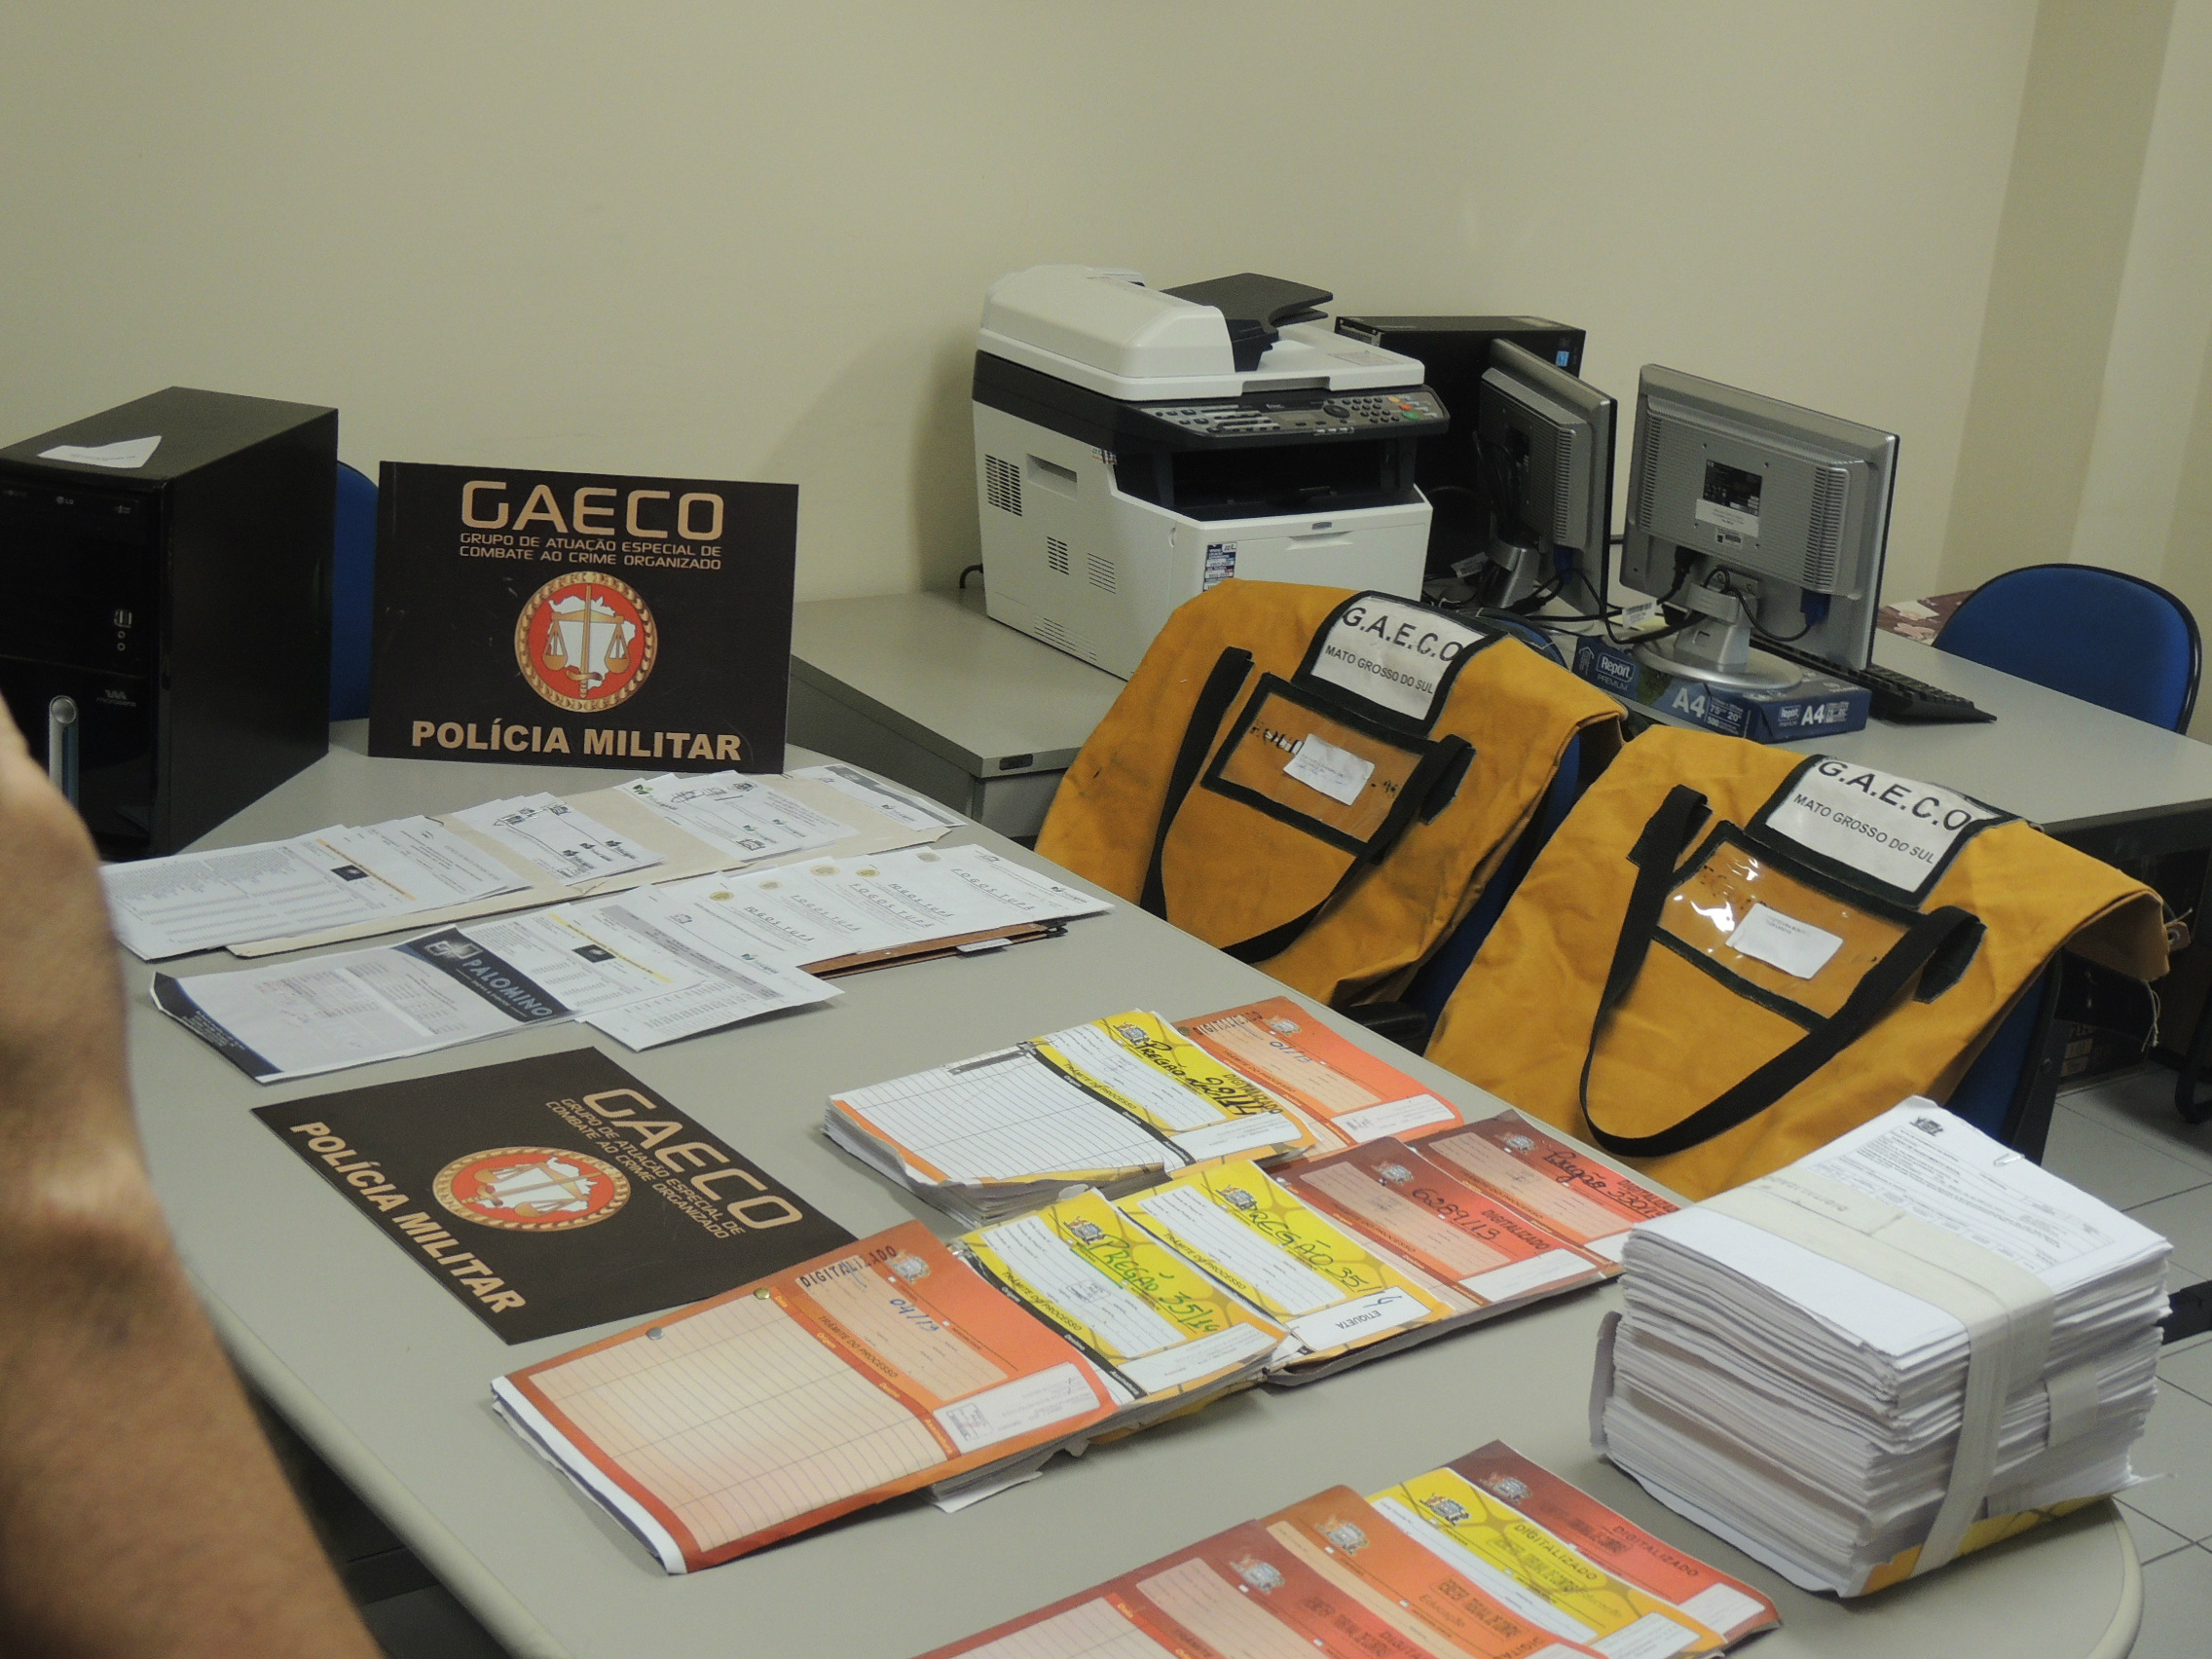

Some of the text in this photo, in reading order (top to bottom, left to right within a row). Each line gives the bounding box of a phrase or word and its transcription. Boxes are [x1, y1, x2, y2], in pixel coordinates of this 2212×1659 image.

[461, 480, 724, 541] GAECO
[460, 533, 722, 557] GRUPO DE ATUAÇÃO ESPECIAL DE
[460, 545, 722, 571] COMBATE AO CRIME ORGANIZADO
[1324, 645, 1434, 695] MATO GROSSO DO SUL
[1601, 656, 1631, 679] Report
[1672, 686, 1706, 719] A4
[1801, 704, 1825, 726] A4
[412, 718, 742, 761] POLÍCIA MILITAR
[1793, 793, 1936, 866] MATO GROSSO DO SUL
[461, 958, 553, 1016] PALOMINO
[1222, 1073, 1284, 1115] DIGITALIZADO
[545, 1100, 730, 1239] COMBATE AO CRIME ORGANIZADO
[560, 1097, 746, 1235] GRUPO DE ATUAÇÃO ESPECIAL DE
[582, 1088, 803, 1230] GAECO
[289, 1120, 527, 1314] POLÍCIA MILITAR
[1481, 1209, 1551, 1251] DIGITALIZADO
[800, 1244, 899, 1289] DIGITALIZADO
[1204, 1261, 1247, 1290] PROCESSO
[1042, 1303, 1083, 1331] PROCESSO
[1335, 1309, 1382, 1331] ETIQUETA
[859, 1347, 899, 1379] PROCESSO
[1513, 1523, 1599, 1580] DIGITALIZADO
[1612, 1525, 1699, 1577] DIGITALIZADO
